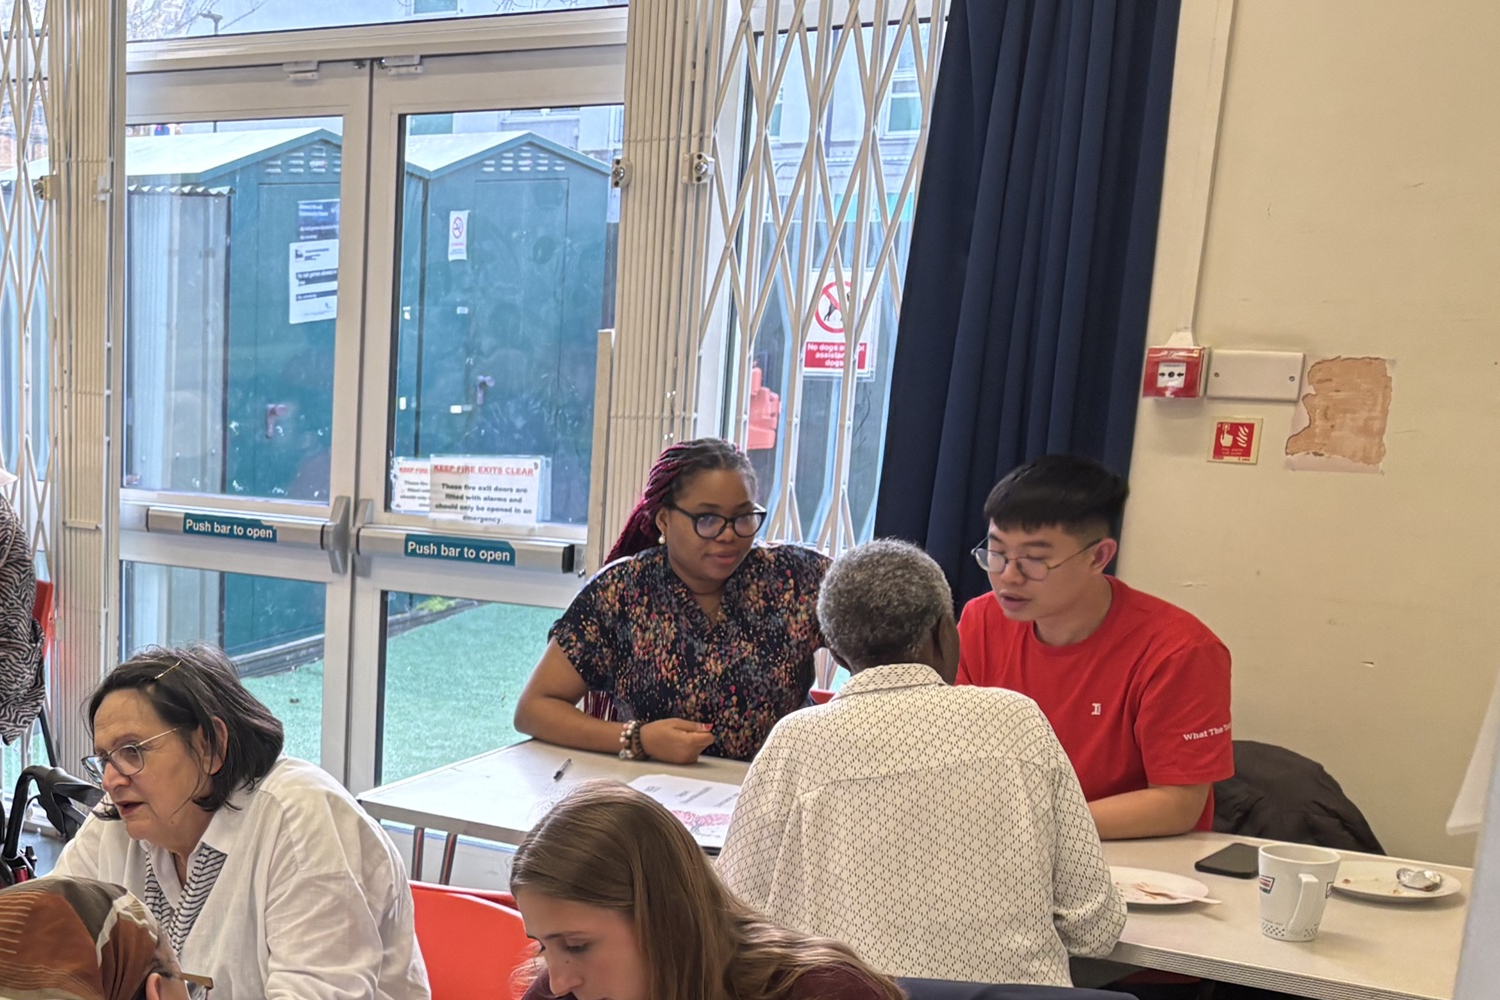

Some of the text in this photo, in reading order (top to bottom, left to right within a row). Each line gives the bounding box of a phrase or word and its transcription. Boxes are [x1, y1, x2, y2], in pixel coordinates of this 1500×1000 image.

[807, 342, 818, 350] No
[819, 343, 838, 353] dogs
[825, 359, 844, 367] dogs
[434, 465, 534, 476] KEEP FIRE EXITS CLEAR
[441, 483, 462, 491] These
[494, 485, 513, 493] doors
[435, 502, 458, 510] should
[459, 504, 474, 512] only
[487, 506, 512, 515] opened
[462, 514, 503, 524] emergency.
[186, 519, 273, 539] Push bar to open
[407, 541, 510, 562] Push bar to open
[1183, 730, 1208, 741] What
[1208, 727, 1224, 737] The
